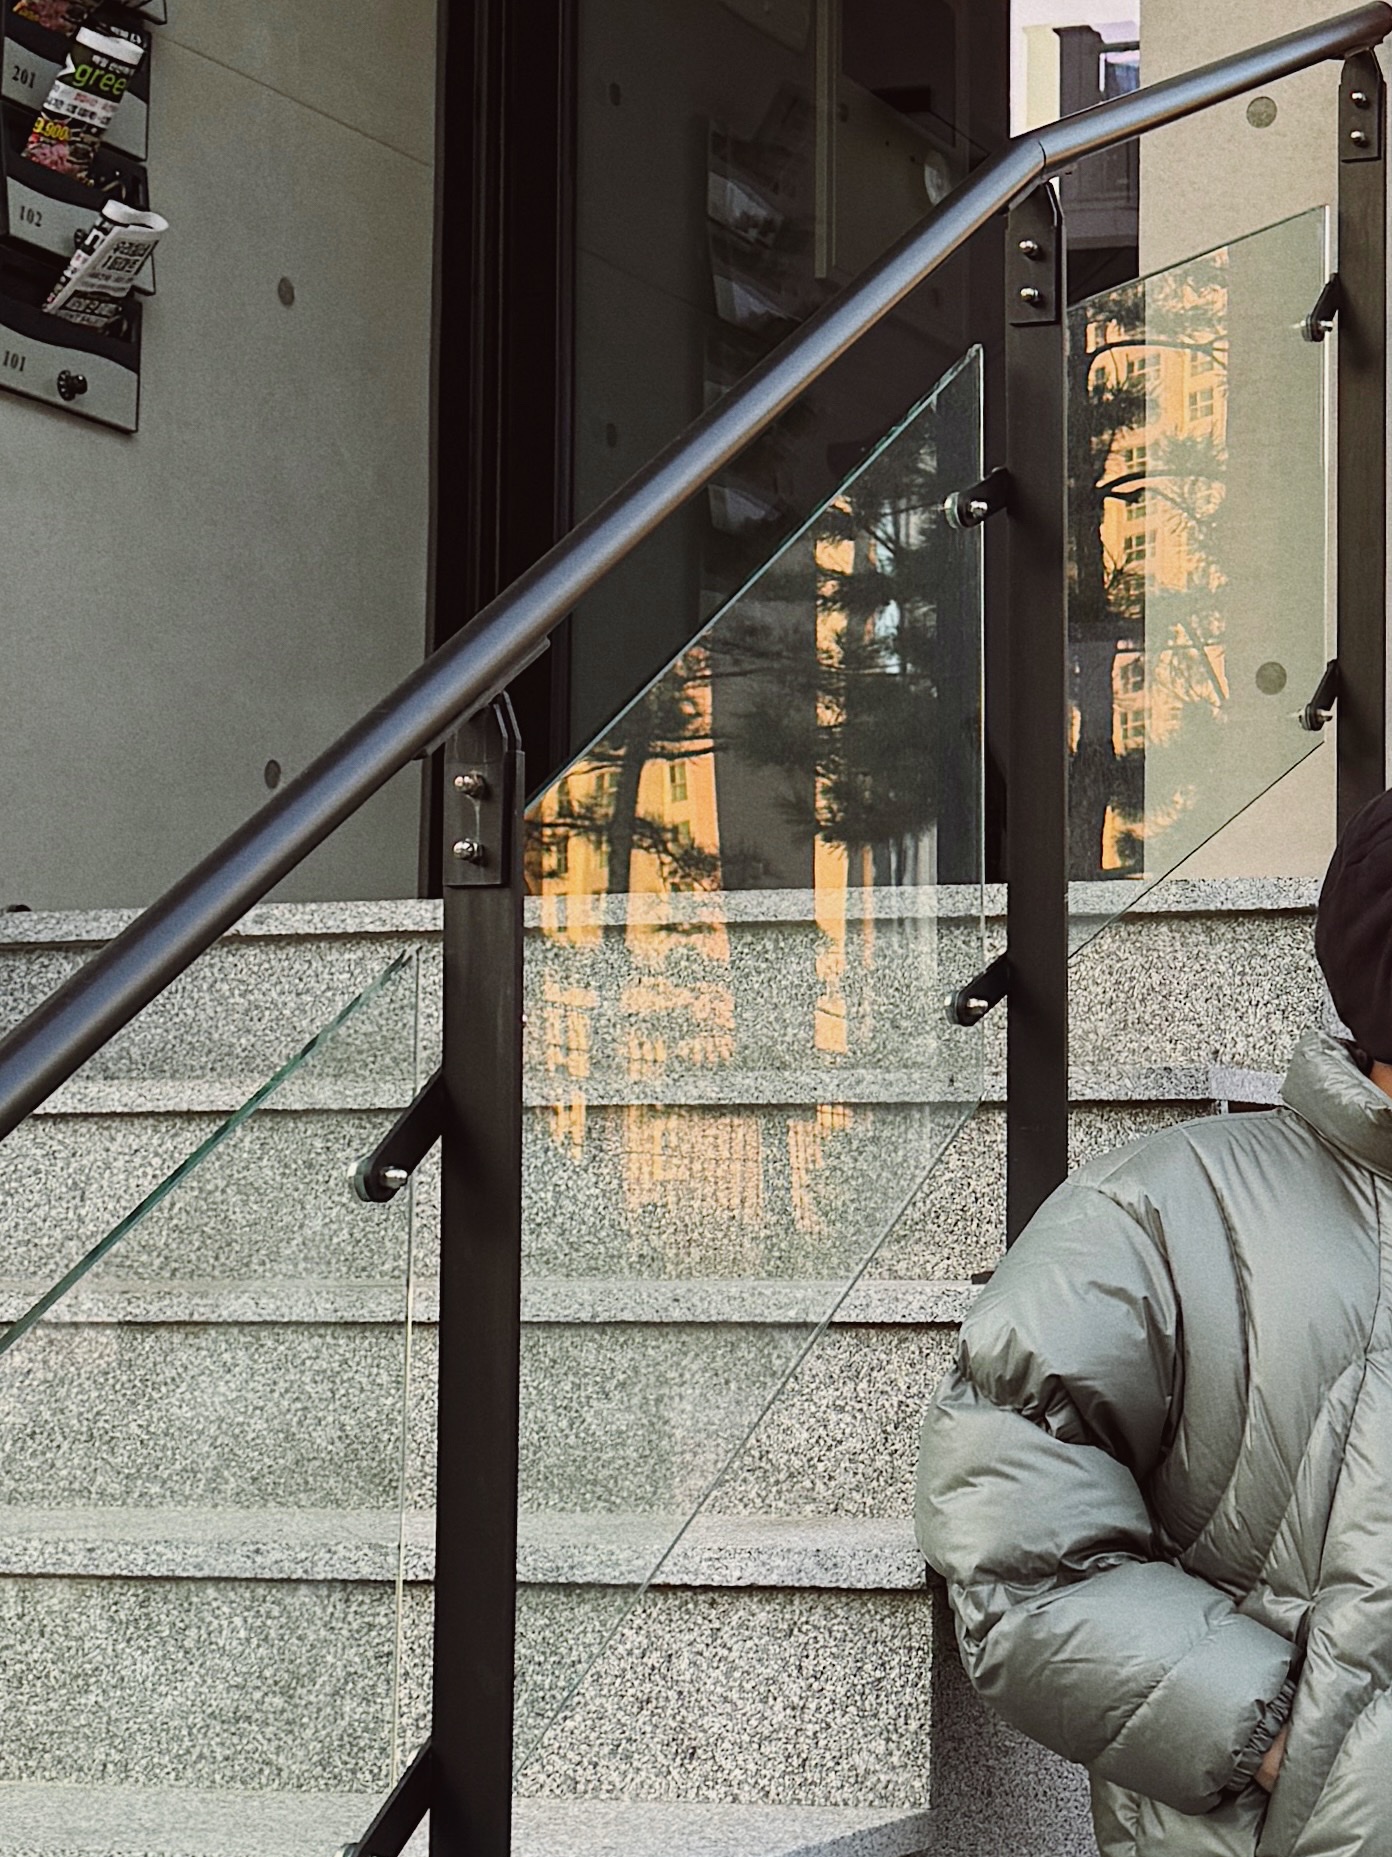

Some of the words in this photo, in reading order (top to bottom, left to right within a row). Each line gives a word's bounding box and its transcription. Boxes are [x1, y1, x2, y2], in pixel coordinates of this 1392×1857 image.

[12, 65, 37, 89] 201
[20, 205, 42, 227] 102
[3, 350, 26, 371] 101
